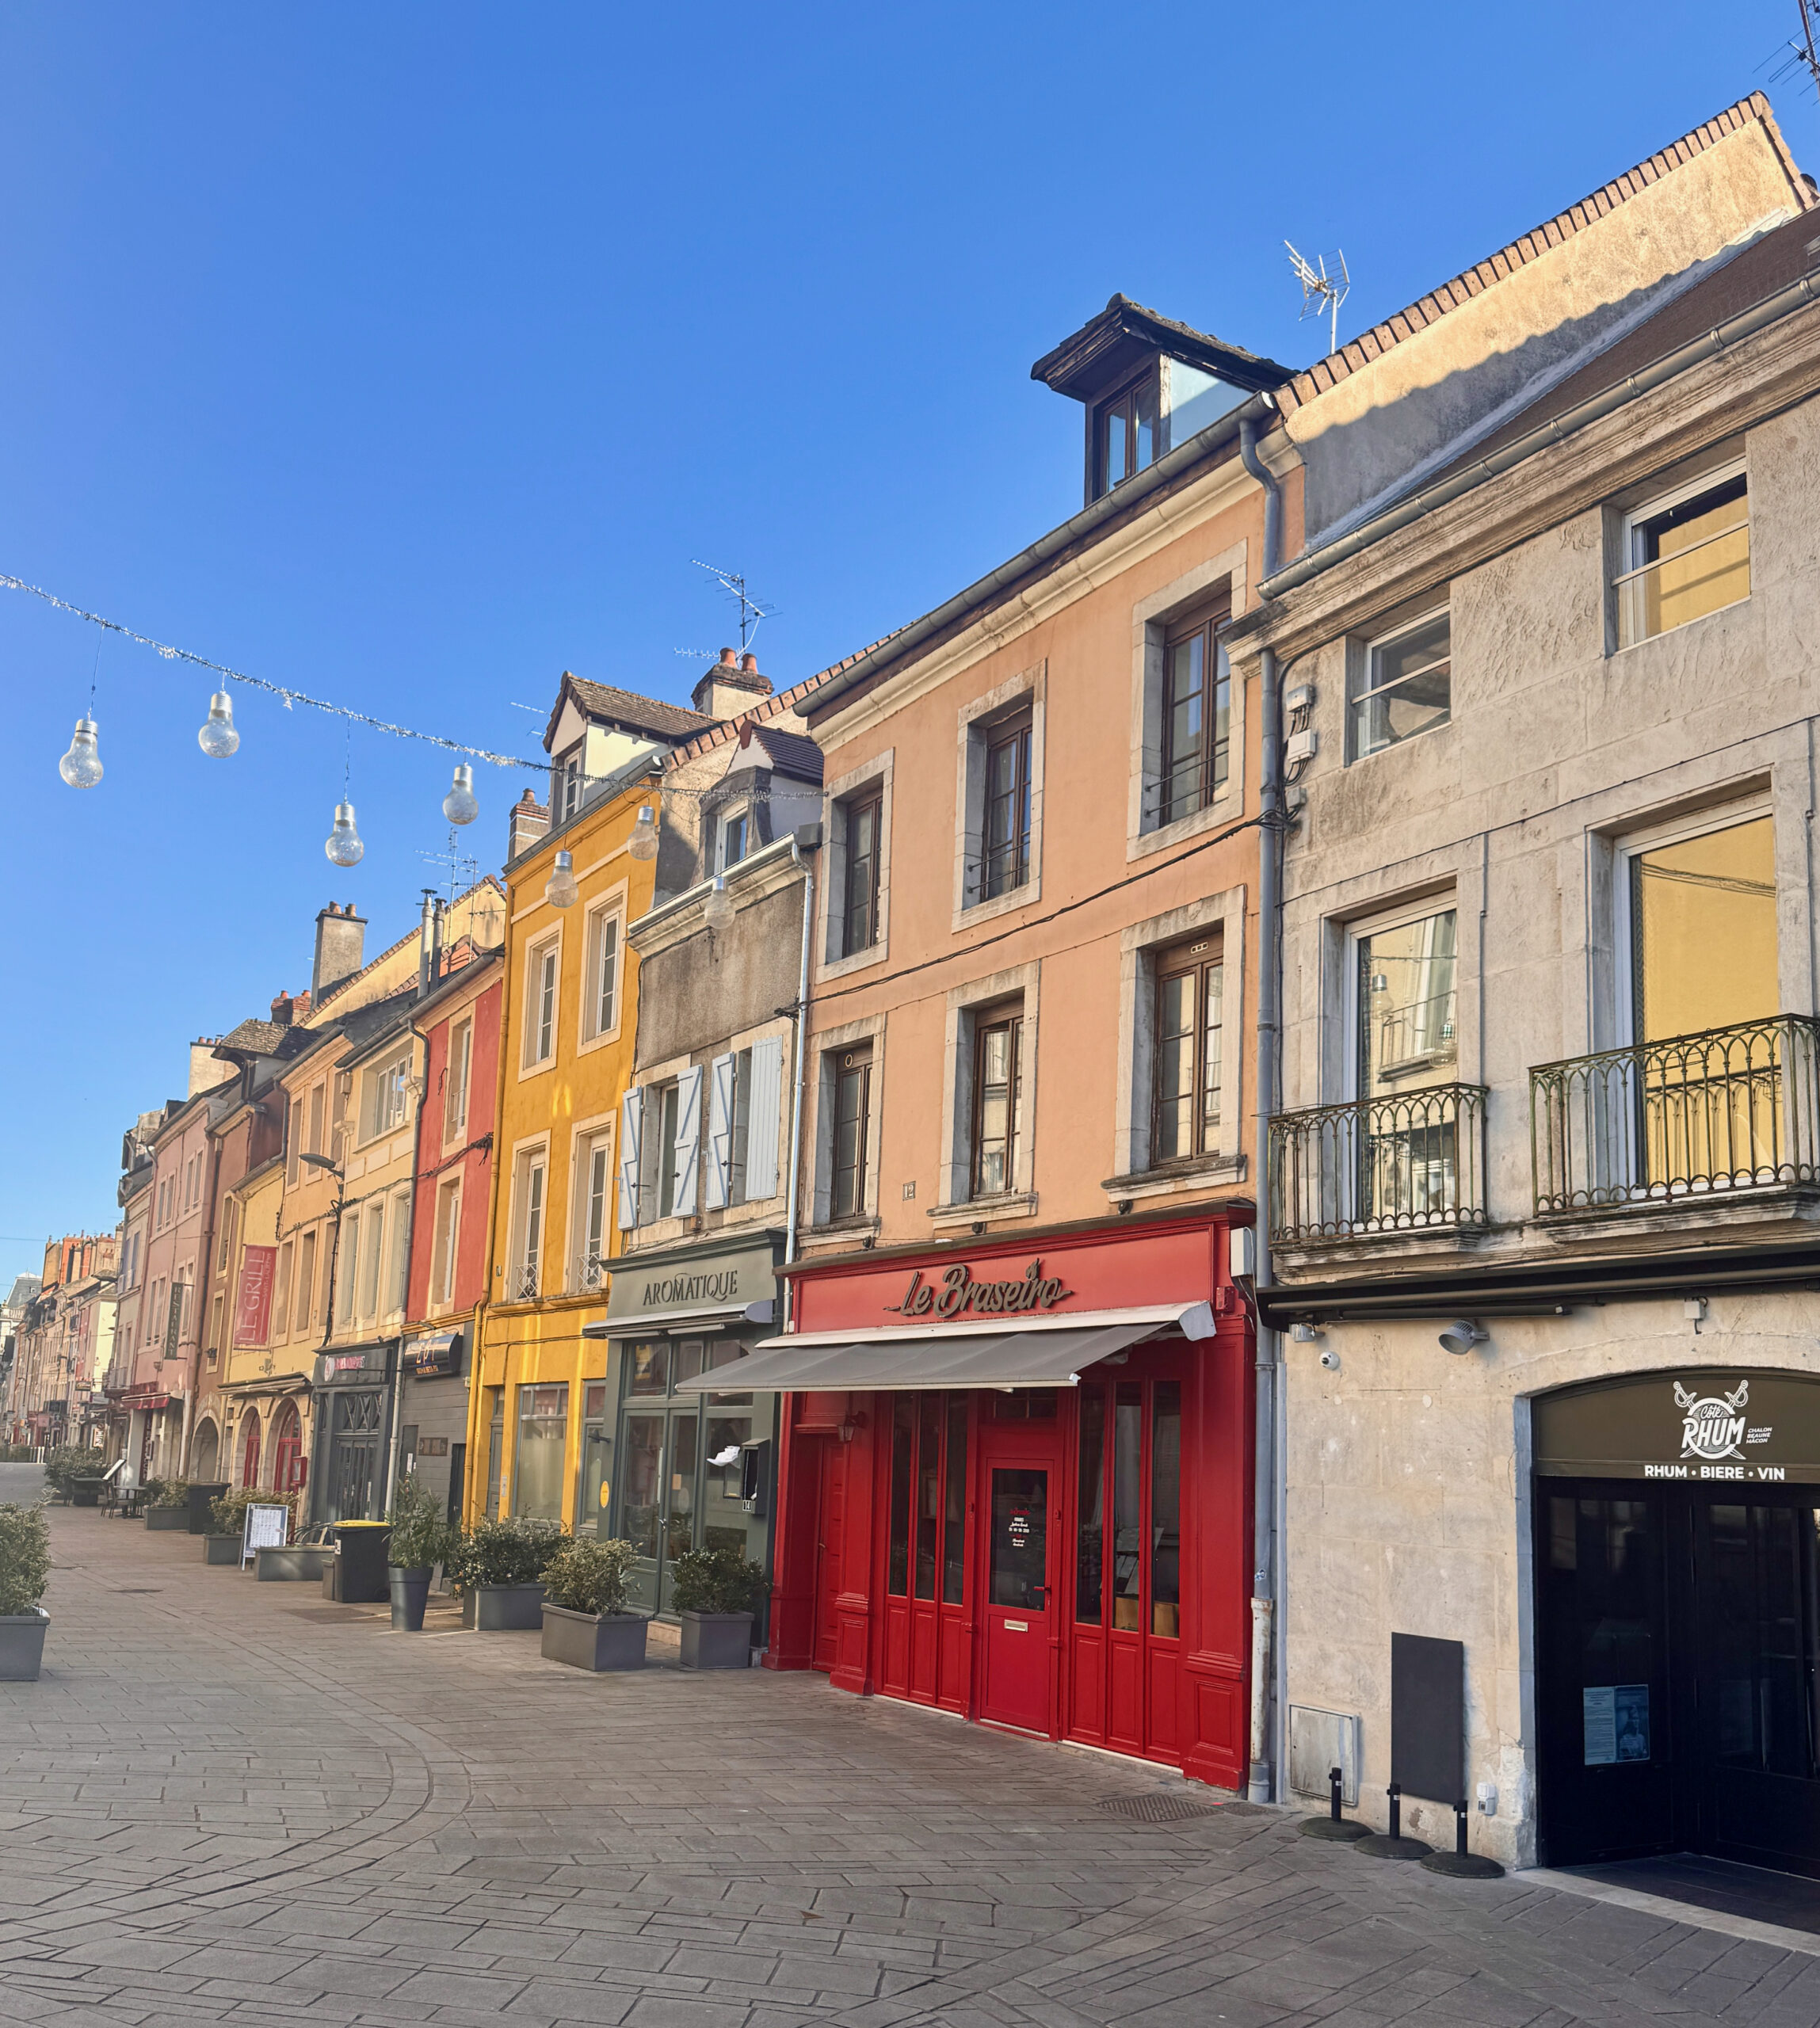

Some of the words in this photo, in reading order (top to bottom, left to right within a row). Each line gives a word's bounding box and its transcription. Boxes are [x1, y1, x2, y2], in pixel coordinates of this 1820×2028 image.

[905, 1184, 914, 1198] 12
[243, 1252, 265, 1310] GRILL
[643, 1270, 738, 1306] AROMATIQUE
[883, 1271, 933, 1317] Le
[933, 1258, 1073, 1317] Braseiro
[238, 1316, 258, 1341] LE
[1700, 1405, 1723, 1420] Côté
[1681, 1416, 1746, 1448] RHUM
[1644, 1465, 1687, 1477] RHUM
[1700, 1466, 1745, 1480] BIERE
[1757, 1467, 1786, 1481] VIN
